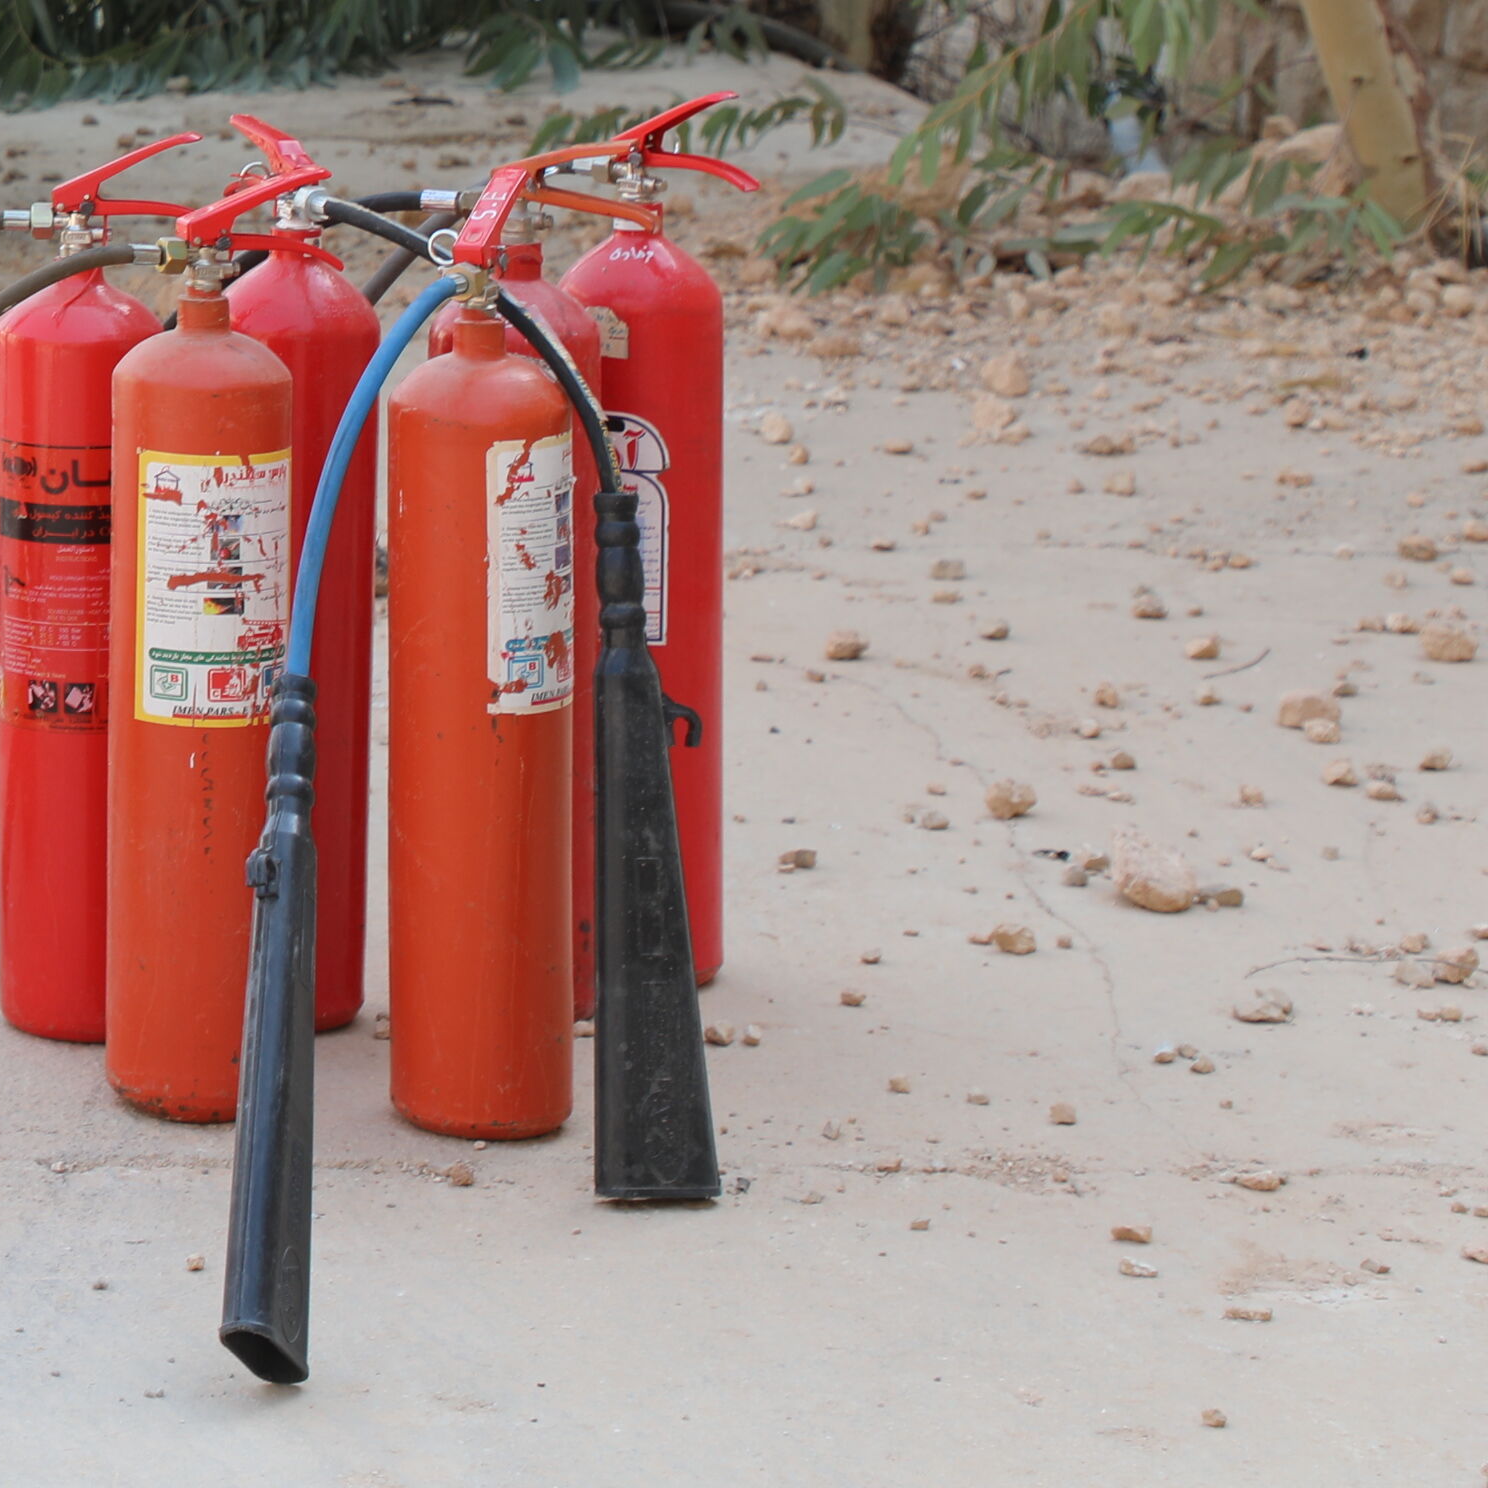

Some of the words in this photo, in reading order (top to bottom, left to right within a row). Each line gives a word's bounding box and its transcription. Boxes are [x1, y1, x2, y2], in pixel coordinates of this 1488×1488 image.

[528, 662, 537, 670] B
[170, 674, 179, 682] B
[212, 690, 220, 698] C
